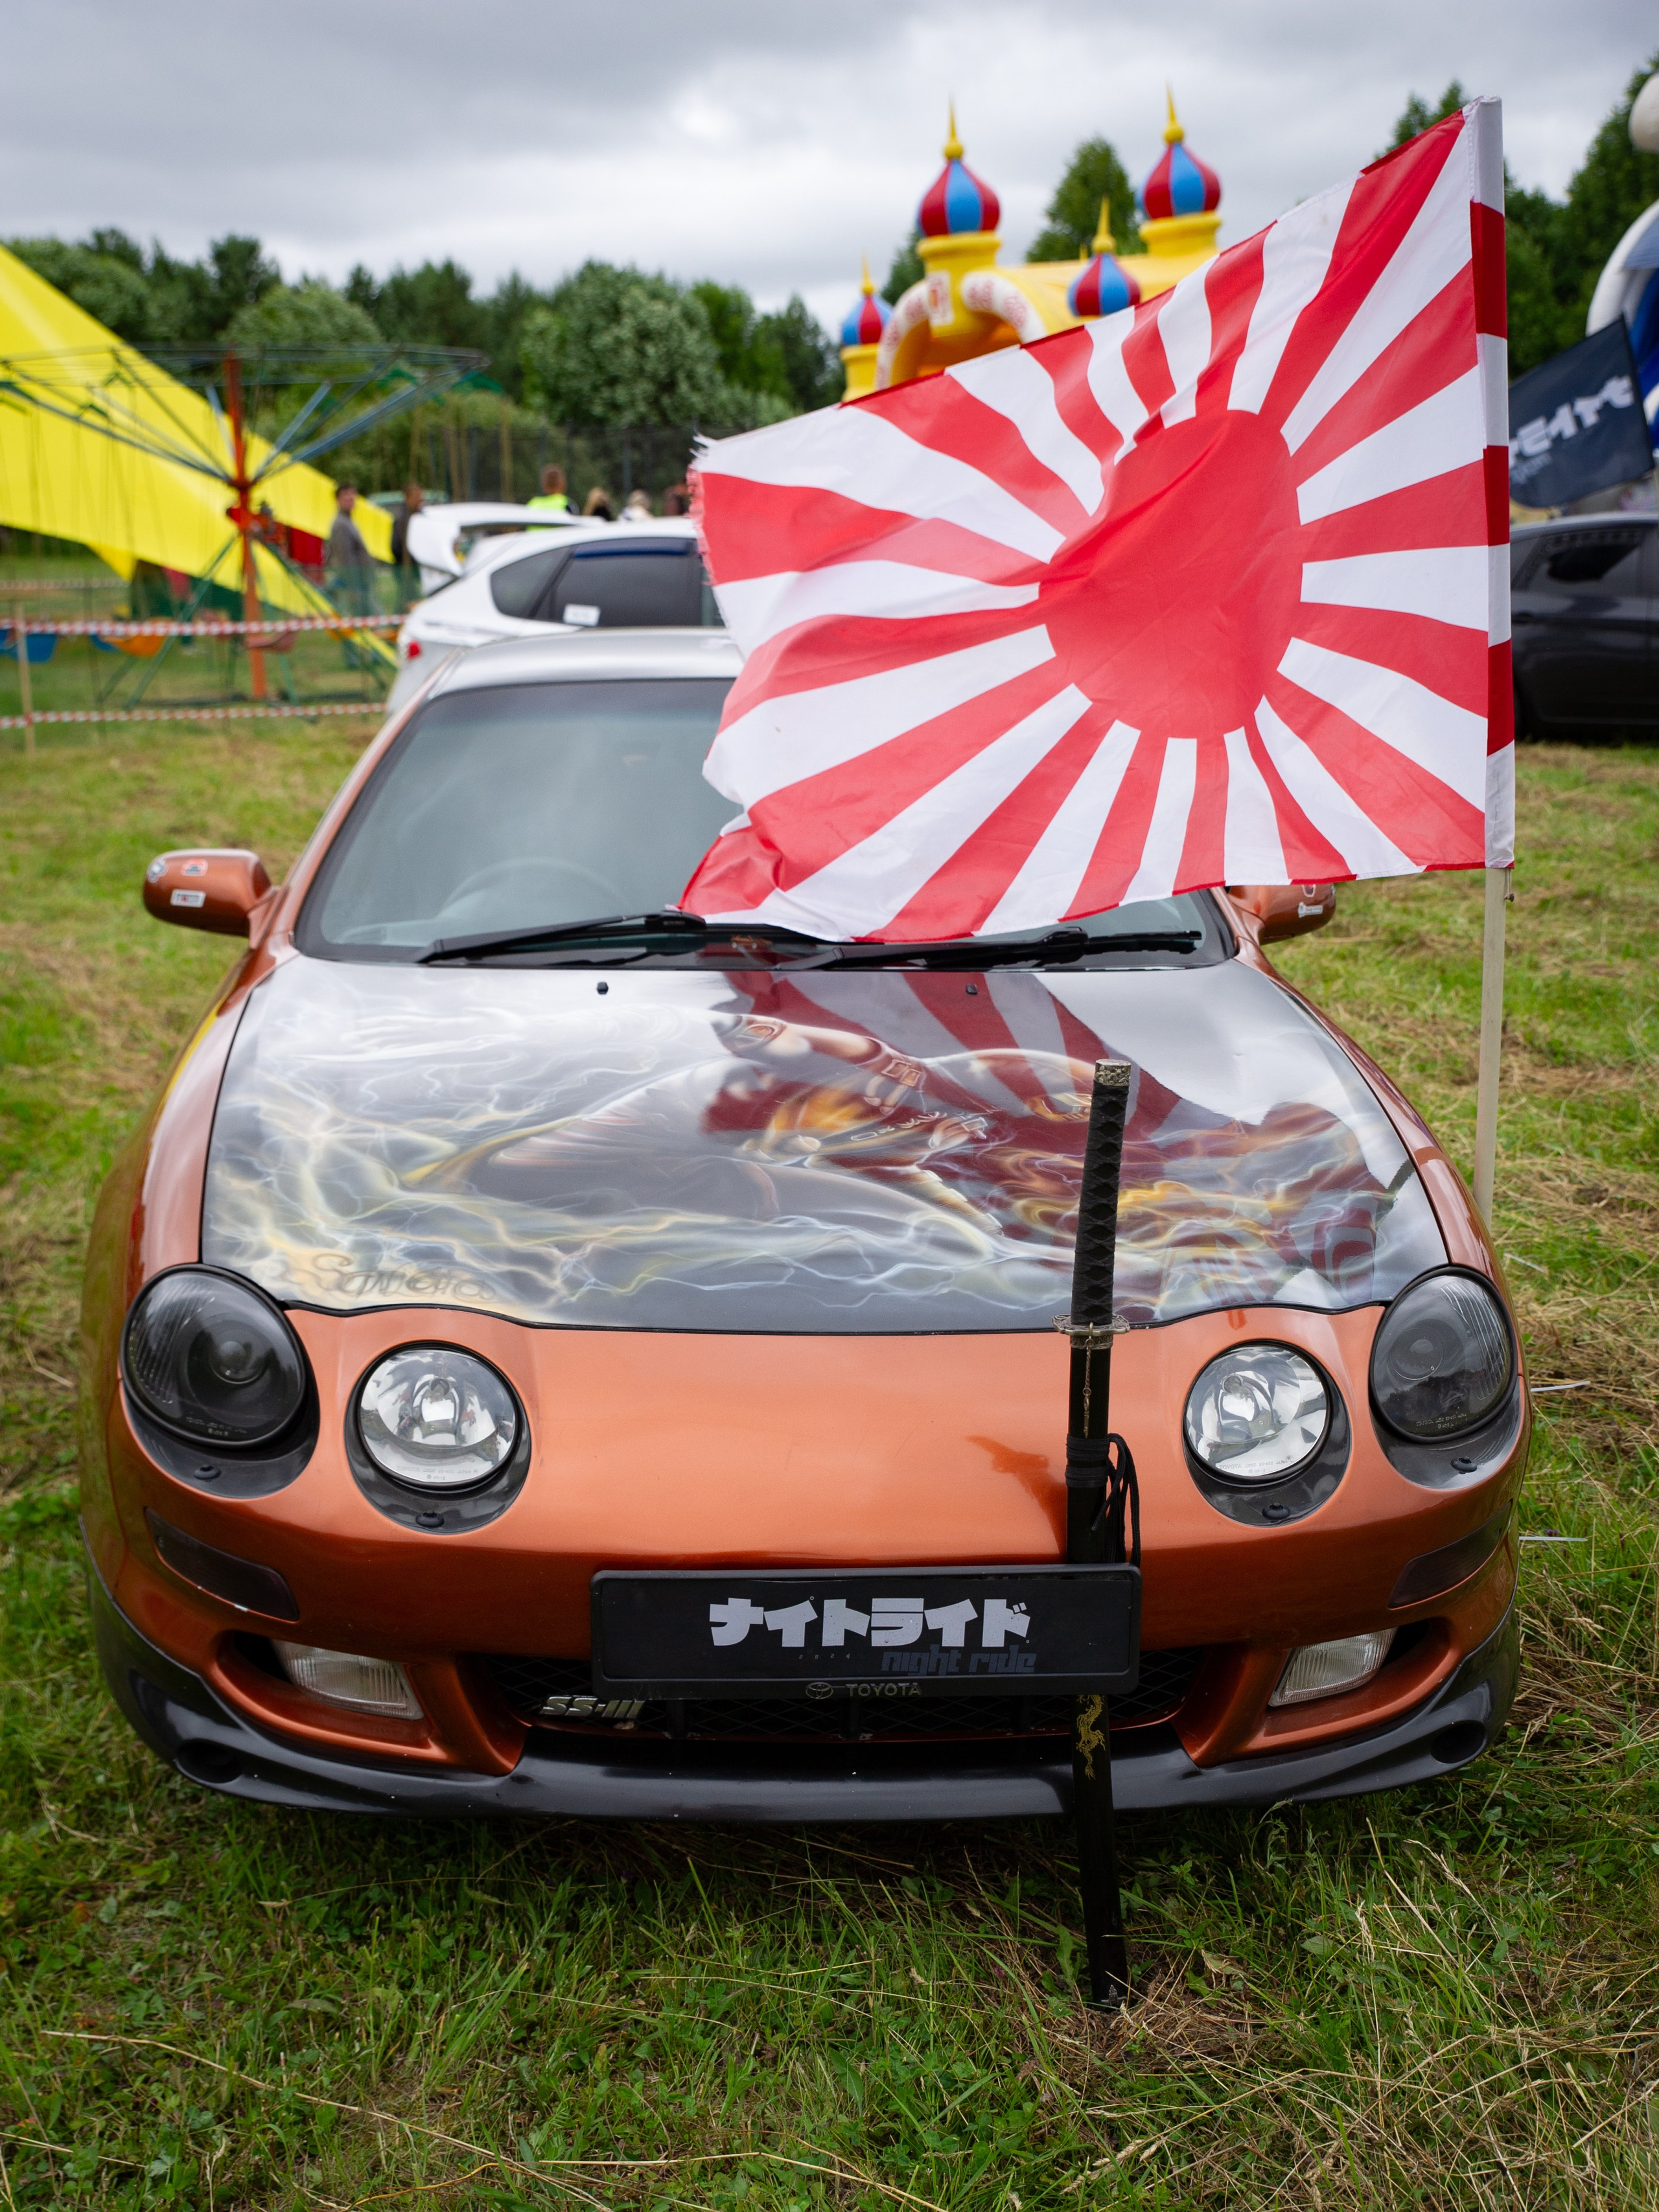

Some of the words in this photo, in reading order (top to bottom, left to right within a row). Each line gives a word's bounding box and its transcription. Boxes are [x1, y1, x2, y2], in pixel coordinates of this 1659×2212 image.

[710, 1598, 1031, 1647] ナイトライド
[881, 1644, 962, 1676] night
[969, 1645, 1037, 1673] ride
[845, 1682, 922, 1697] TOYOTA
